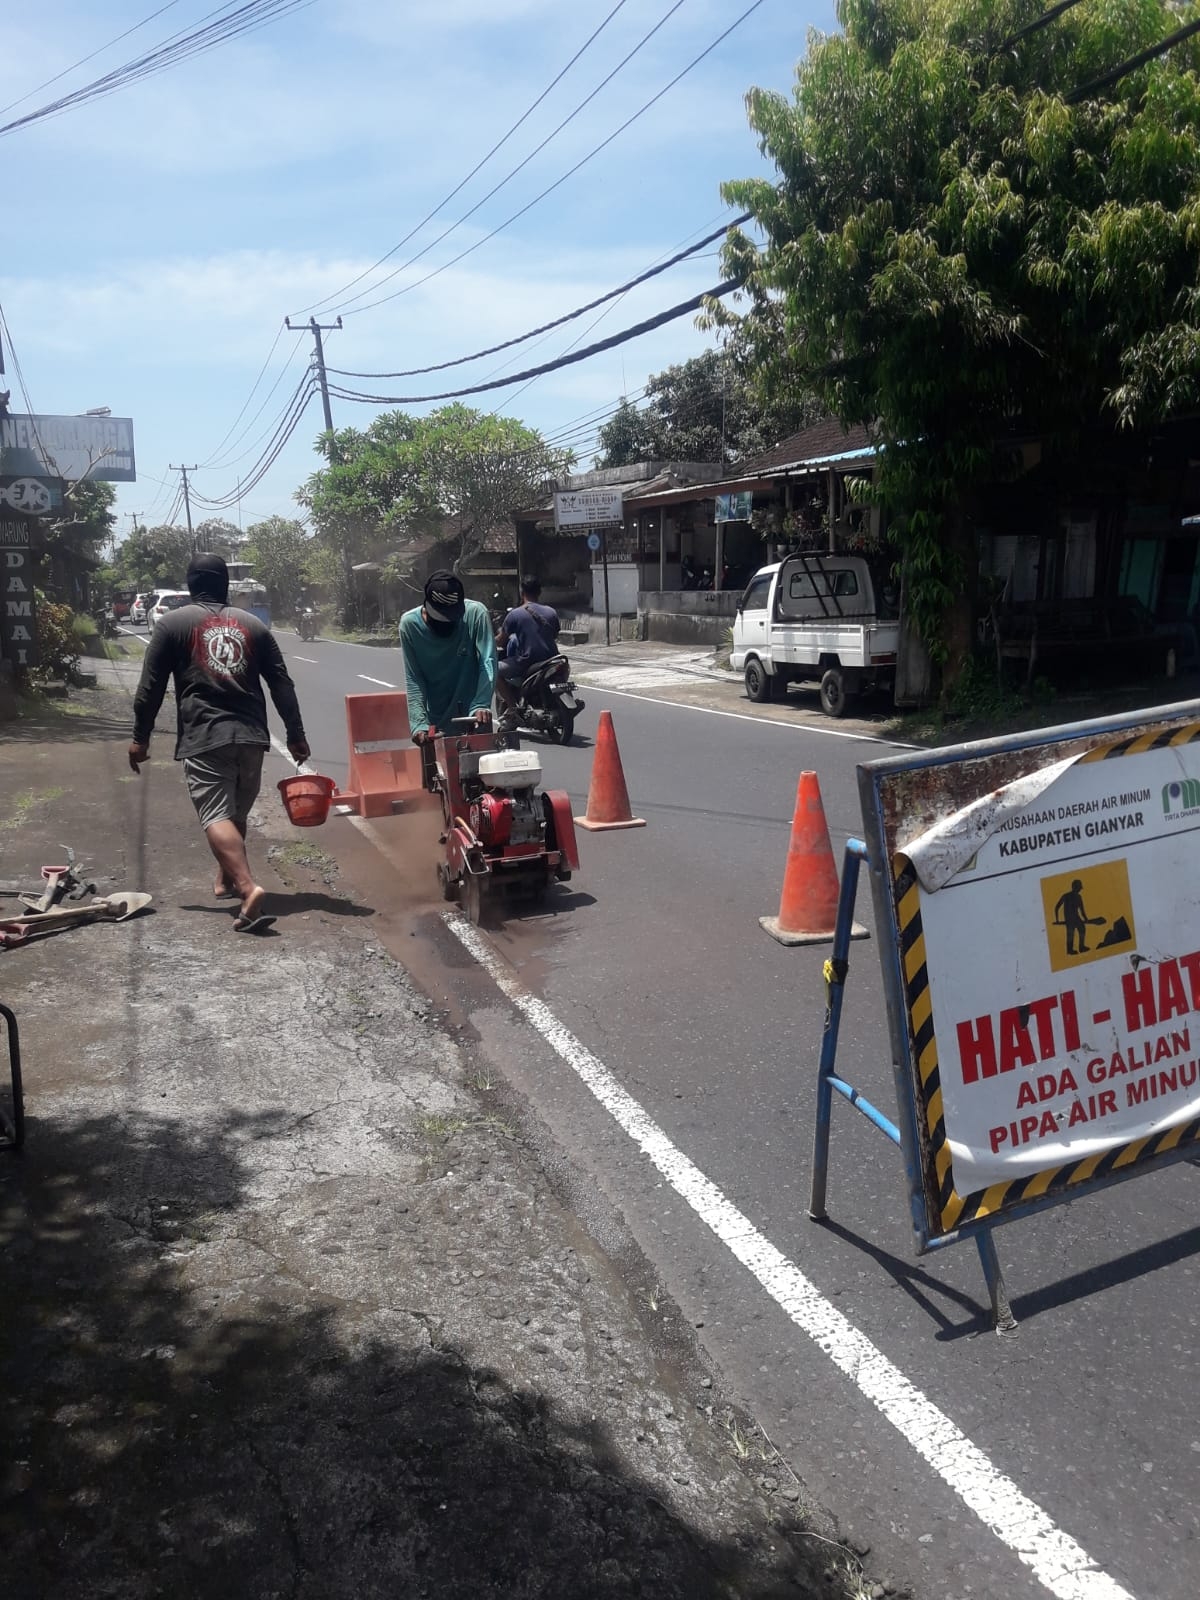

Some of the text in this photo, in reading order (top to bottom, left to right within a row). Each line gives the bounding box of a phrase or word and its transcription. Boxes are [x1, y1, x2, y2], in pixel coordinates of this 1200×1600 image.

[994, 788, 1151, 833] RUSAHAAN DAERAH AIR MINUM
[999, 812, 1144, 857] KABUPATEN GIANYAR
[956, 990, 1081, 1085] HATI
[1016, 1028, 1191, 1109] ADA GALIAN
[989, 1058, 1200, 1154] PIPA AIR MINU
